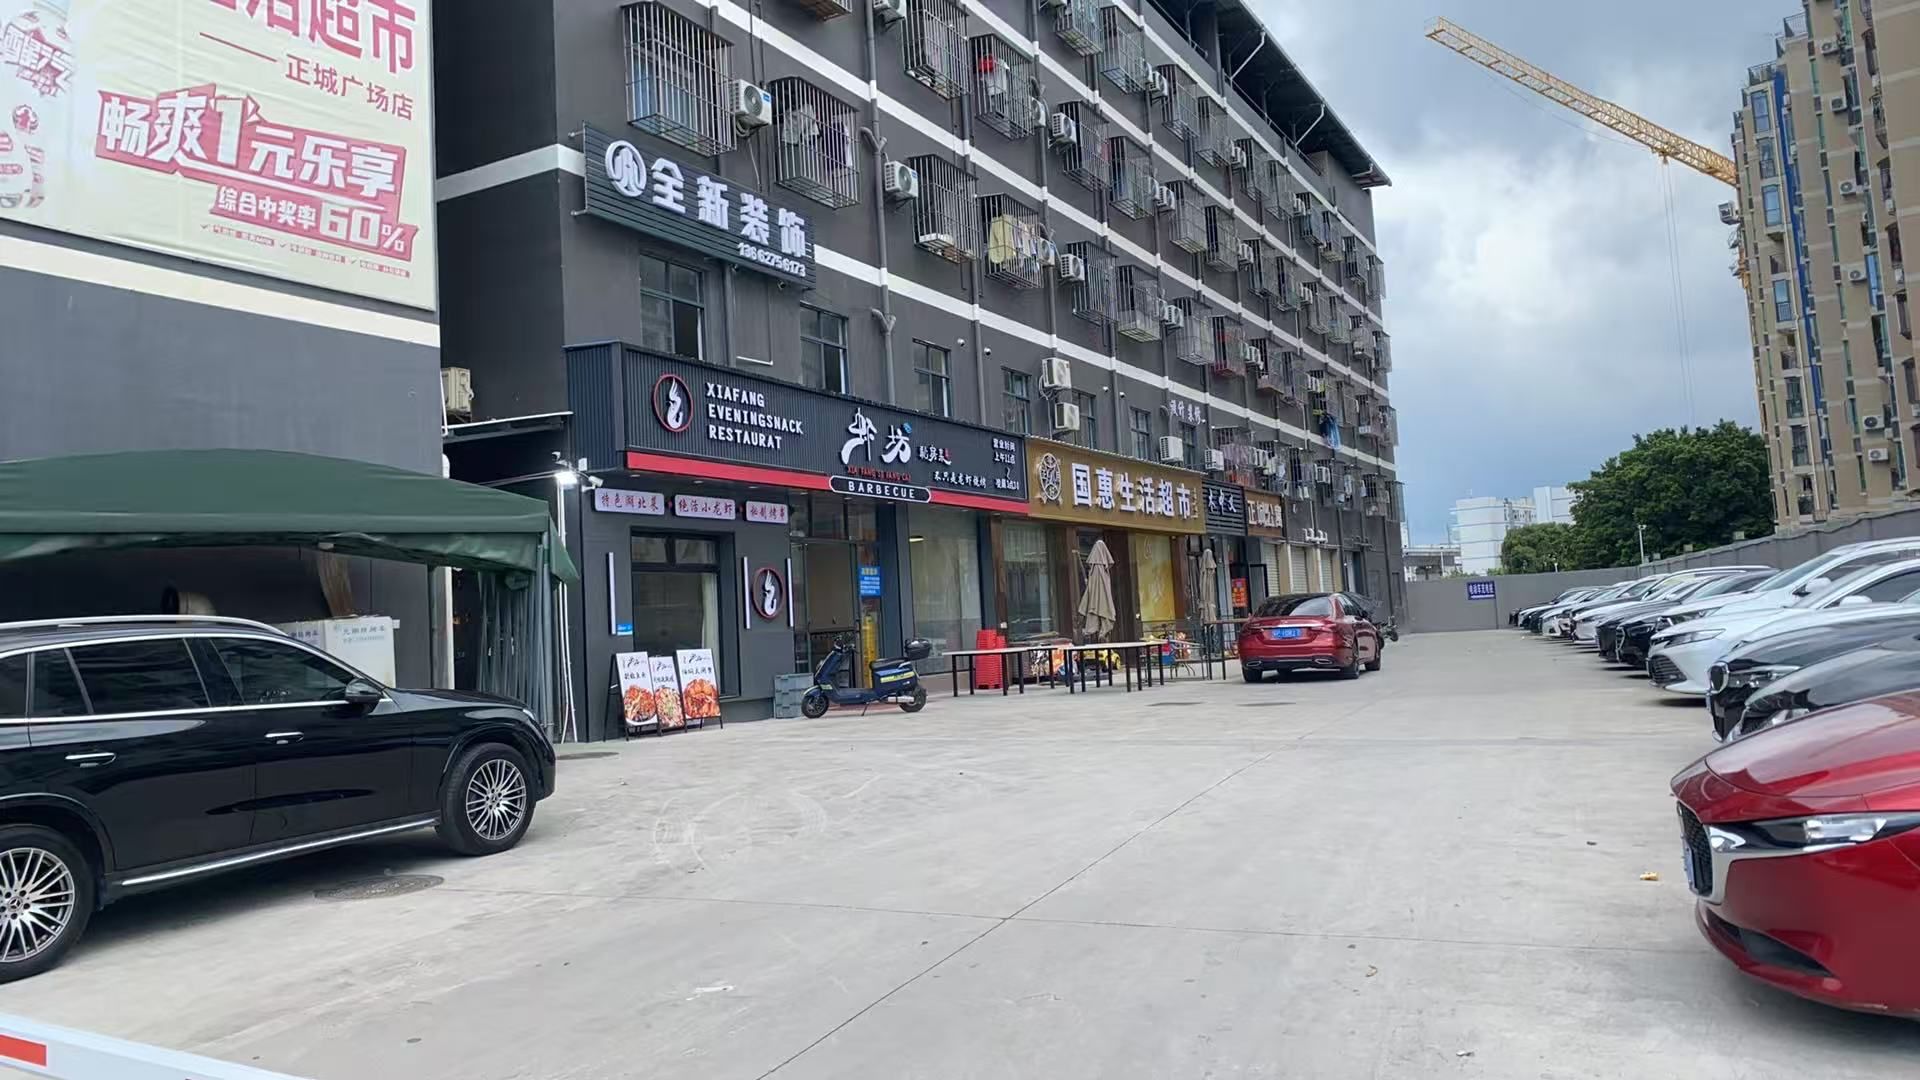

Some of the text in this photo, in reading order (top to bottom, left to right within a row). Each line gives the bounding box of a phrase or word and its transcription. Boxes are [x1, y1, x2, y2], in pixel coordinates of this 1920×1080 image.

[285, 53, 414, 121] 正城广场店
[101, 90, 400, 199] 畅爽1元乐享
[216, 186, 406, 254] 综合中奖率60%
[651, 157, 806, 257] 全新装饰
[706, 382, 766, 408] XIAFANG
[708, 403, 804, 435] EVENINGSNACK
[708, 423, 783, 450] RESTAURAT
[992, 437, 1016, 452] 营业时间
[994, 451, 1016, 465] 上午11点
[848, 480, 916, 499] BARBECUE
[1071, 462, 1191, 520] 国惠生活超市
